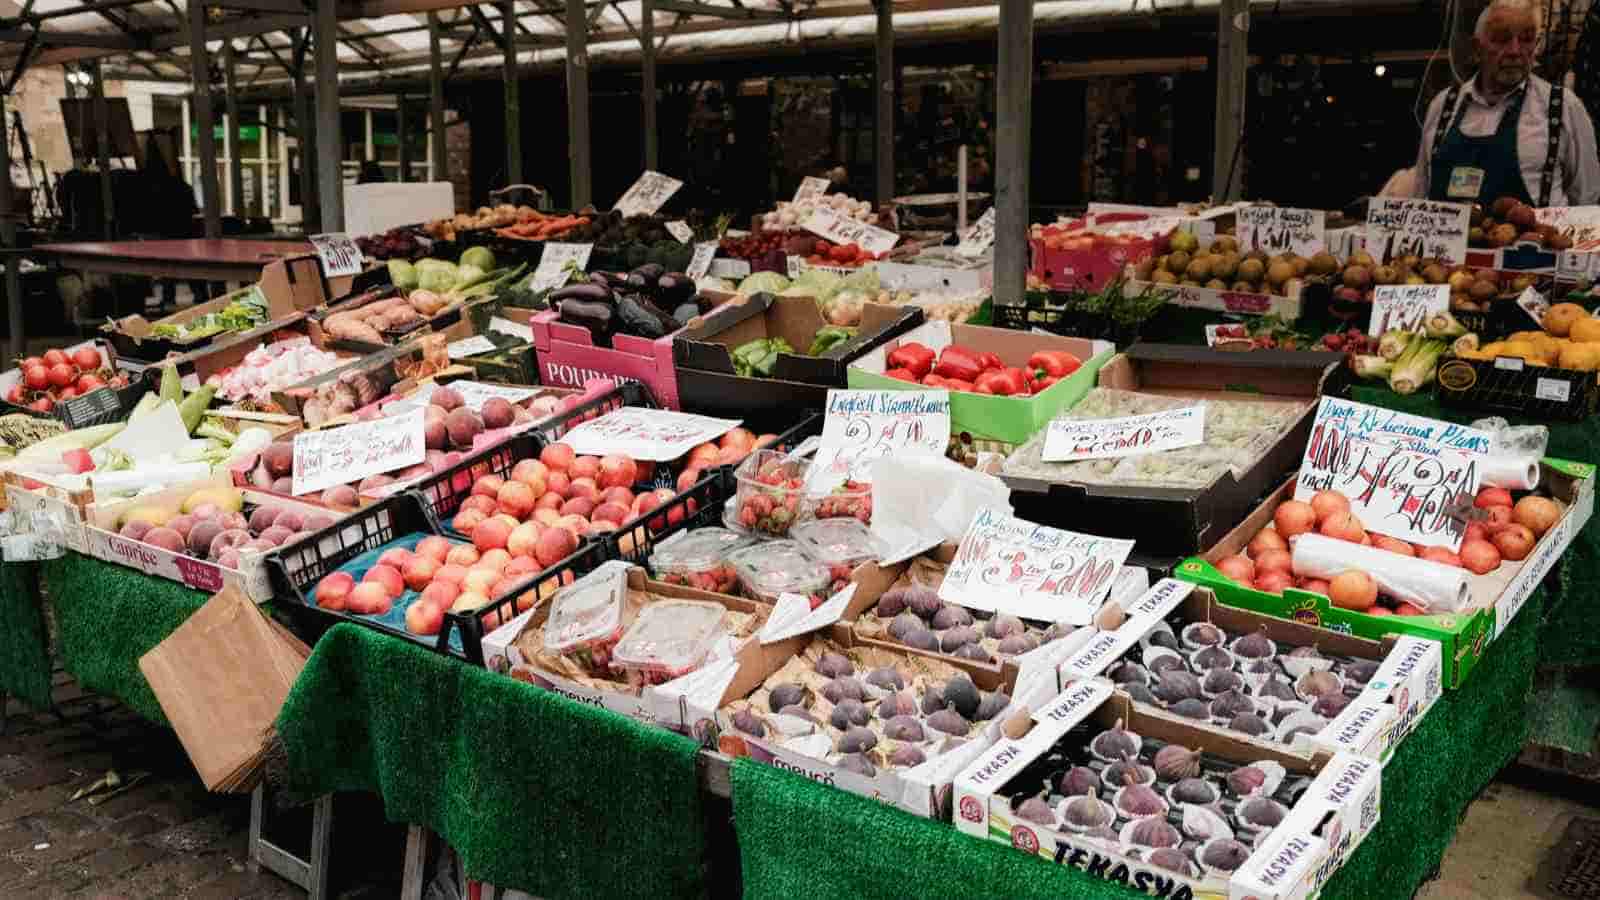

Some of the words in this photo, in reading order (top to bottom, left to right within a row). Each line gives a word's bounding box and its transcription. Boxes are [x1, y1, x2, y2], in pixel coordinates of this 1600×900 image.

[108, 536, 158, 569] Caprice
[1073, 635, 1119, 669] TEKASYA
[1047, 685, 1097, 722] TEKASYA
[969, 744, 1024, 785] TEKASYA
[1053, 839, 1194, 900] TEKASYA
[1260, 837, 1310, 887] TEKASYA
